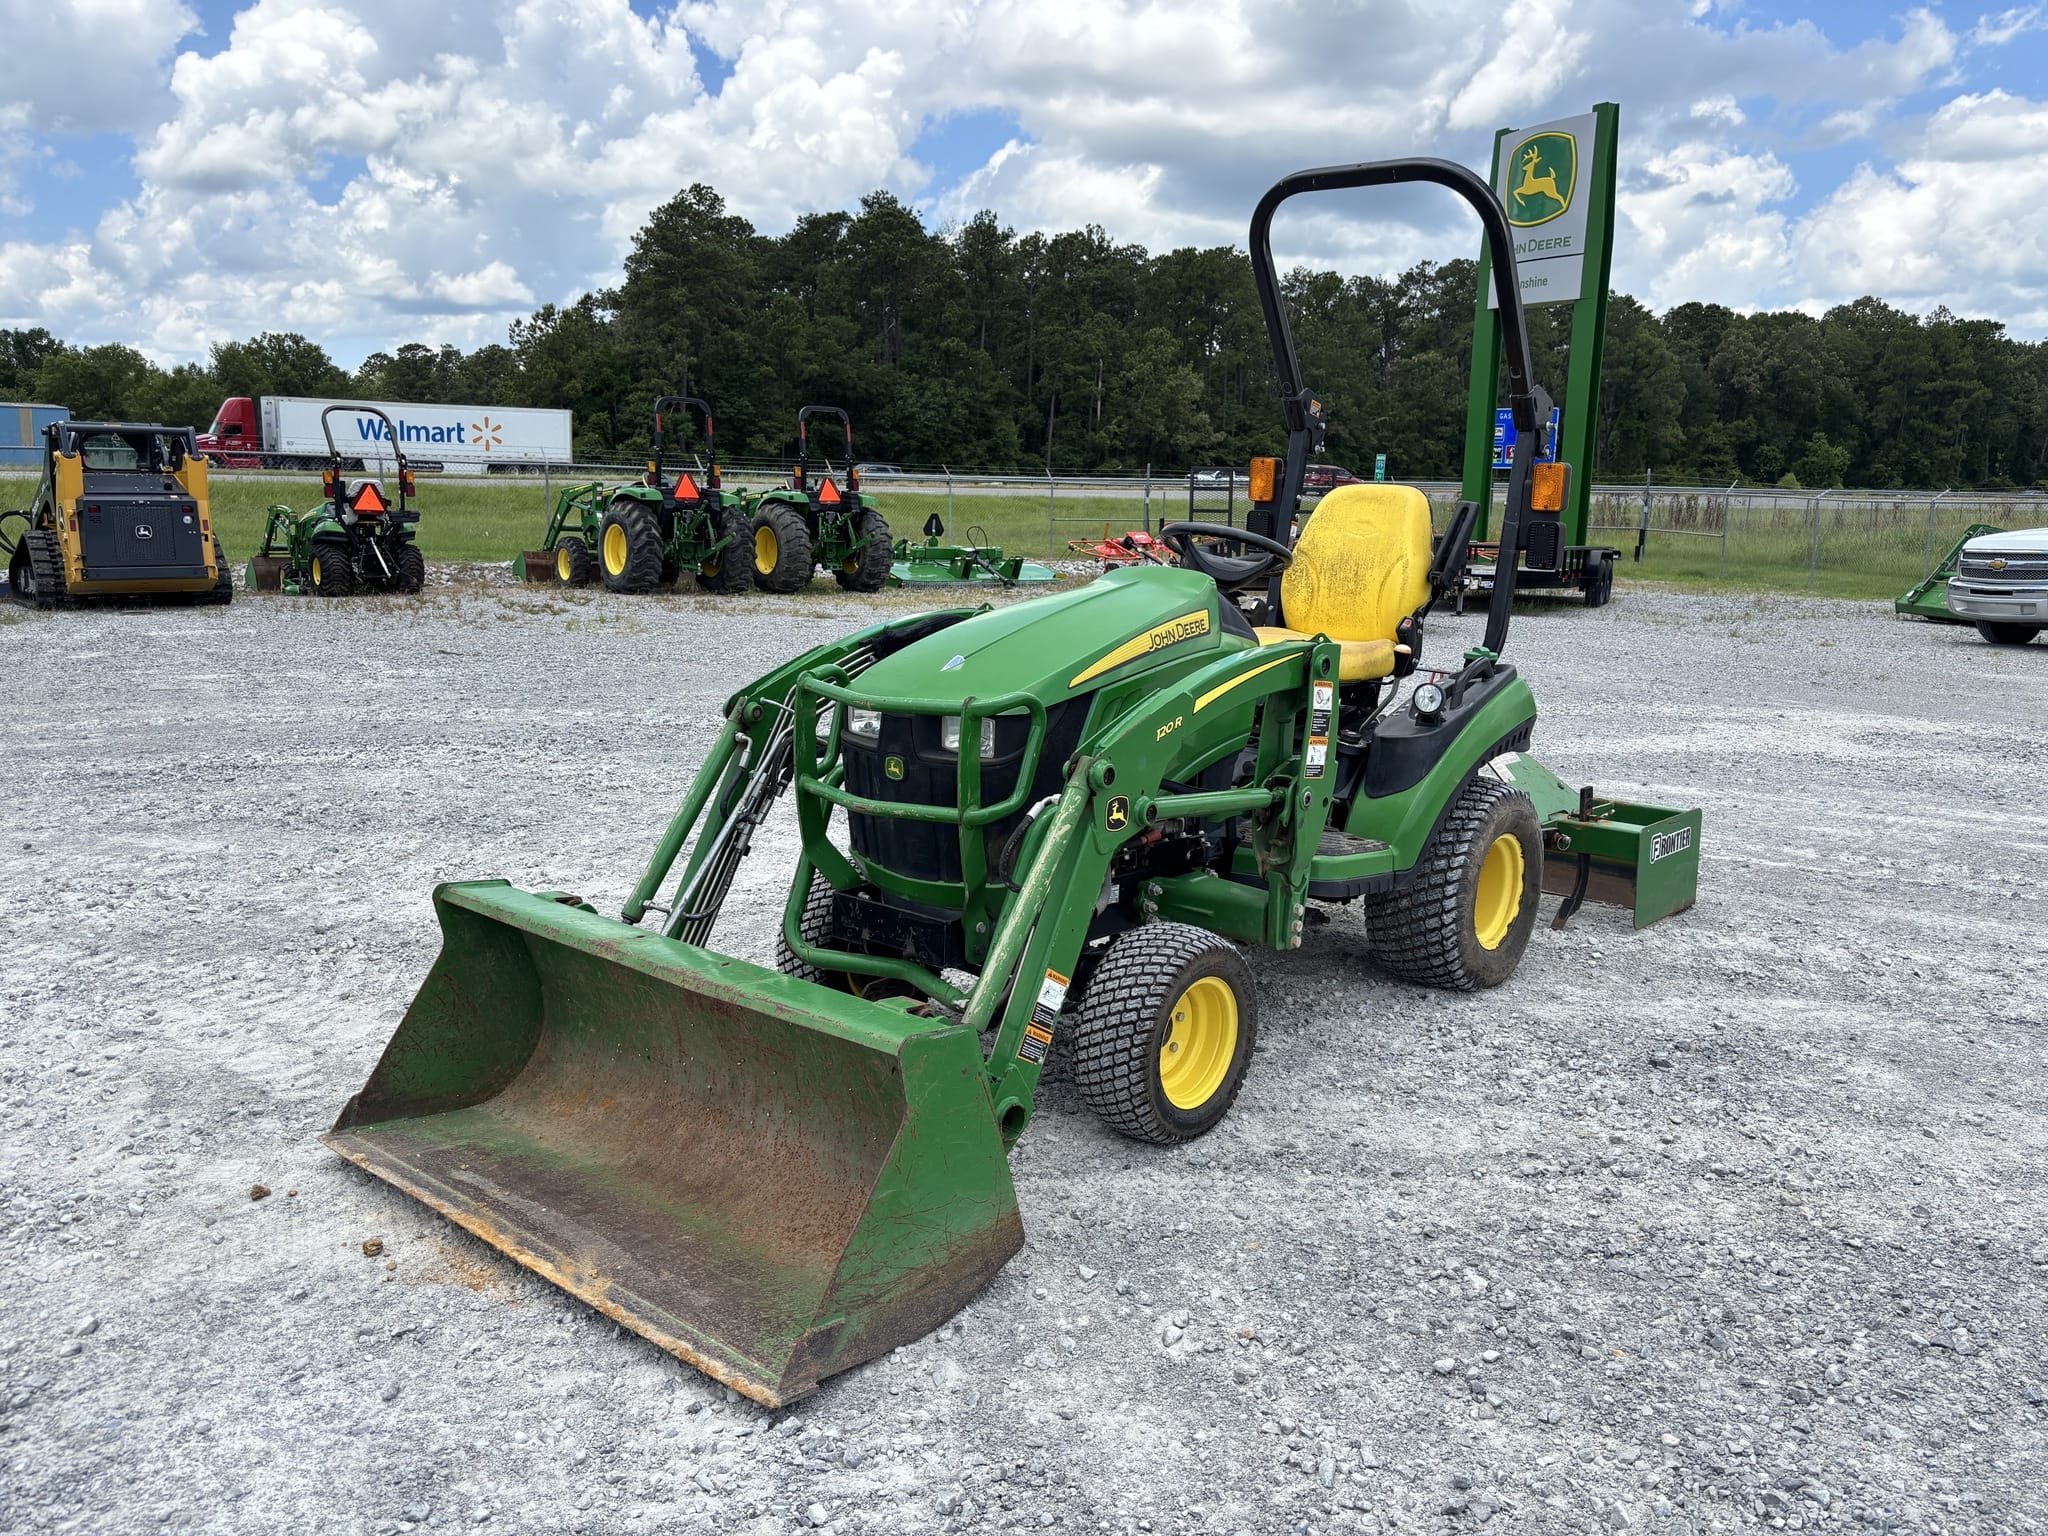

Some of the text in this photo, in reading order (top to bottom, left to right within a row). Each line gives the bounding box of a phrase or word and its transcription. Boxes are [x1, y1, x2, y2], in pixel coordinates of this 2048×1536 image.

[1528, 236, 1572, 252] DEERE
[1520, 276, 1548, 288] nshine
[1499, 412, 1512, 420] GAS
[357, 418, 465, 443] Walmart
[1149, 619, 1206, 650] JOHN DEERE
[1650, 827, 1691, 864] FRONTIER
